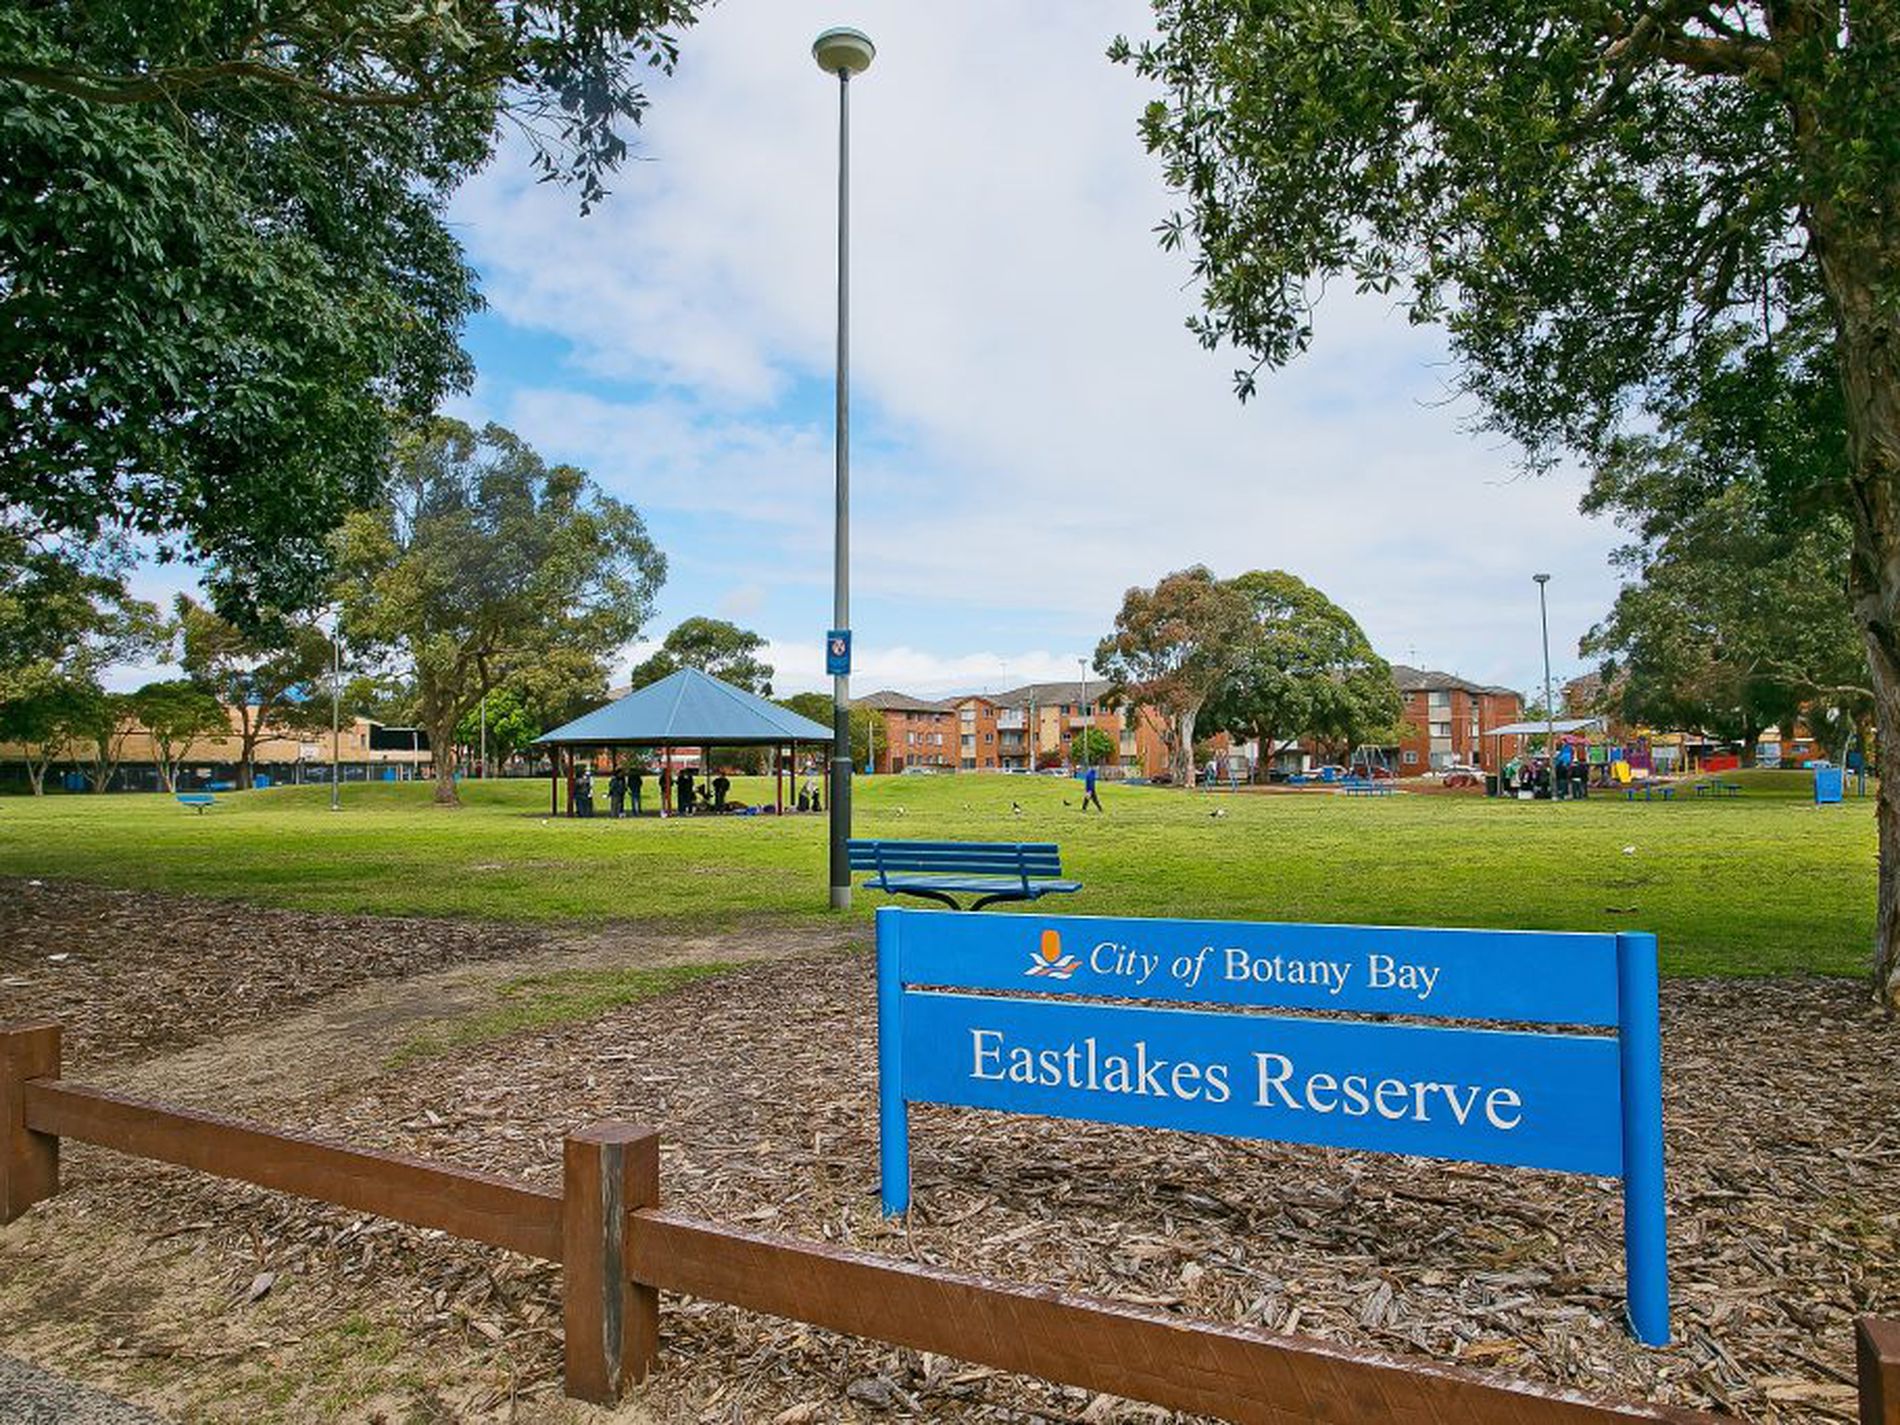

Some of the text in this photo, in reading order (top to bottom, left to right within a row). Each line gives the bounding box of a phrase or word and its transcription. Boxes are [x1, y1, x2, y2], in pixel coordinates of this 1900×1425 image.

[1089, 941, 1441, 1000] City of Botany Bay
[969, 1028, 1522, 1131] Eastlakes Reserve
